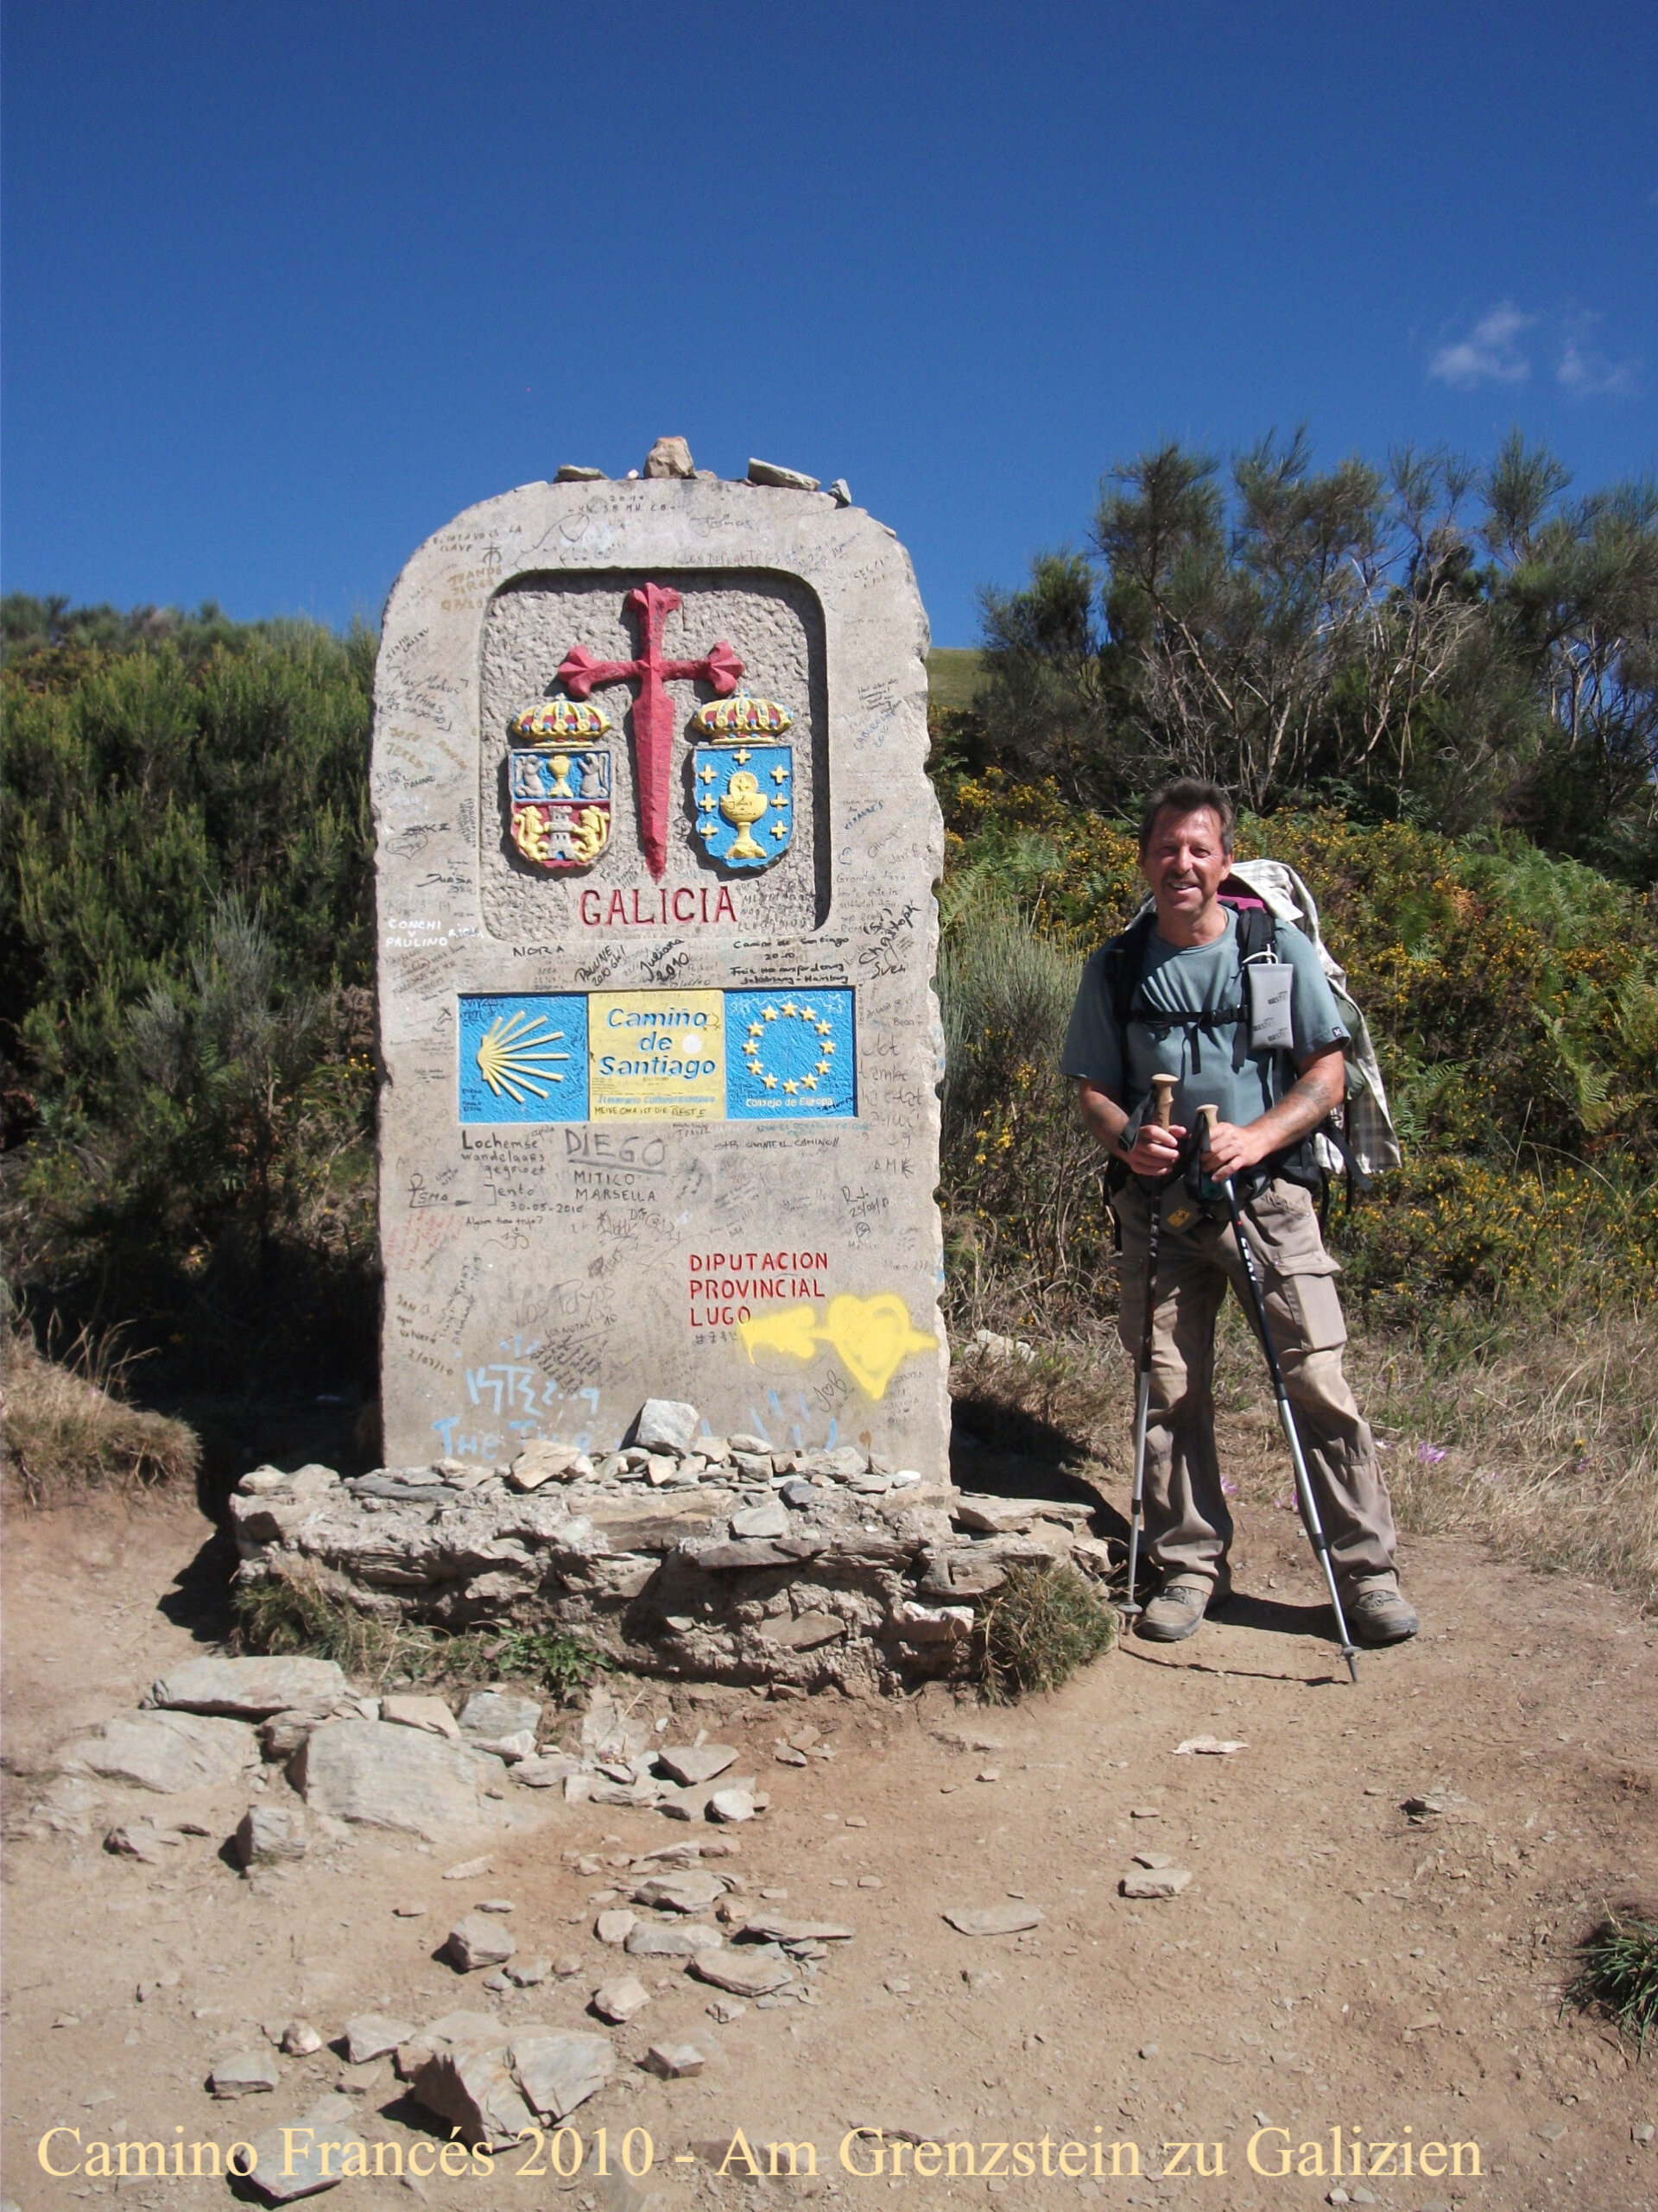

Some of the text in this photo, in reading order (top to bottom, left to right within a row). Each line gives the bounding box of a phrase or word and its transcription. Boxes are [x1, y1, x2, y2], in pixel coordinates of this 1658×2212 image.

[580, 886, 737, 927] GALICIA
[389, 918, 441, 931] CONCHI
[385, 936, 448, 948] PAULINO
[513, 945, 565, 957] NORA
[574, 945, 613, 983] PAULINE
[870, 961, 906, 980] Sven
[639, 1031, 673, 1052] de
[598, 1055, 717, 1079] Santiago
[745, 1096, 834, 1109] Consejo de Europa
[462, 1129, 539, 1150] Lochemse
[573, 1169, 636, 1187] MITICO
[575, 1188, 656, 1203] MARSELLA
[689, 1252, 828, 1272] DIPUTACION
[689, 1278, 826, 1300] PROVINCIAL
[690, 1305, 751, 1327] LUGO
